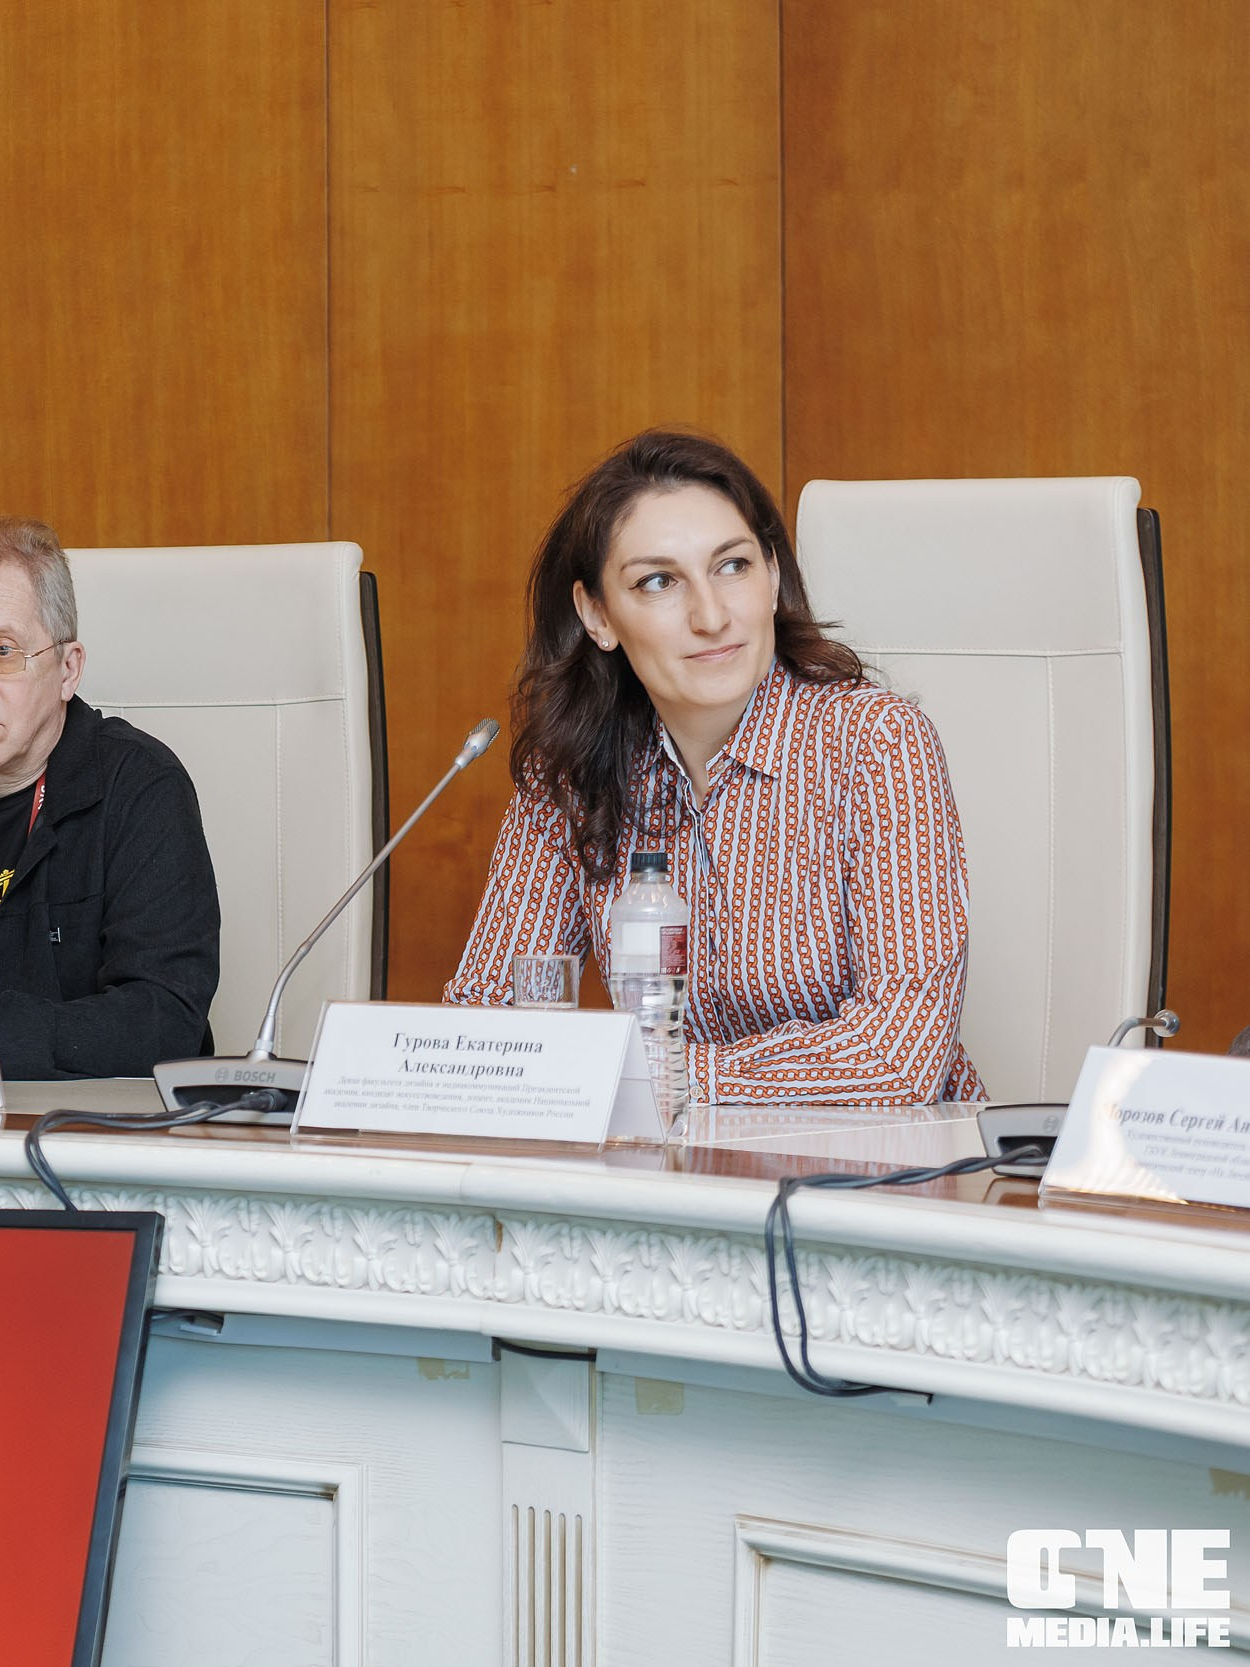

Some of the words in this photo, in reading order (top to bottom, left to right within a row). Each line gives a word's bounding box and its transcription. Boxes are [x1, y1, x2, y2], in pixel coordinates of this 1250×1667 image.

[393, 1031, 450, 1051] Гурова
[455, 1034, 544, 1055] Екатерина
[234, 1070, 276, 1083] BOSCH
[397, 1058, 525, 1080] Александровна
[1168, 1107, 1226, 1132] Сергей
